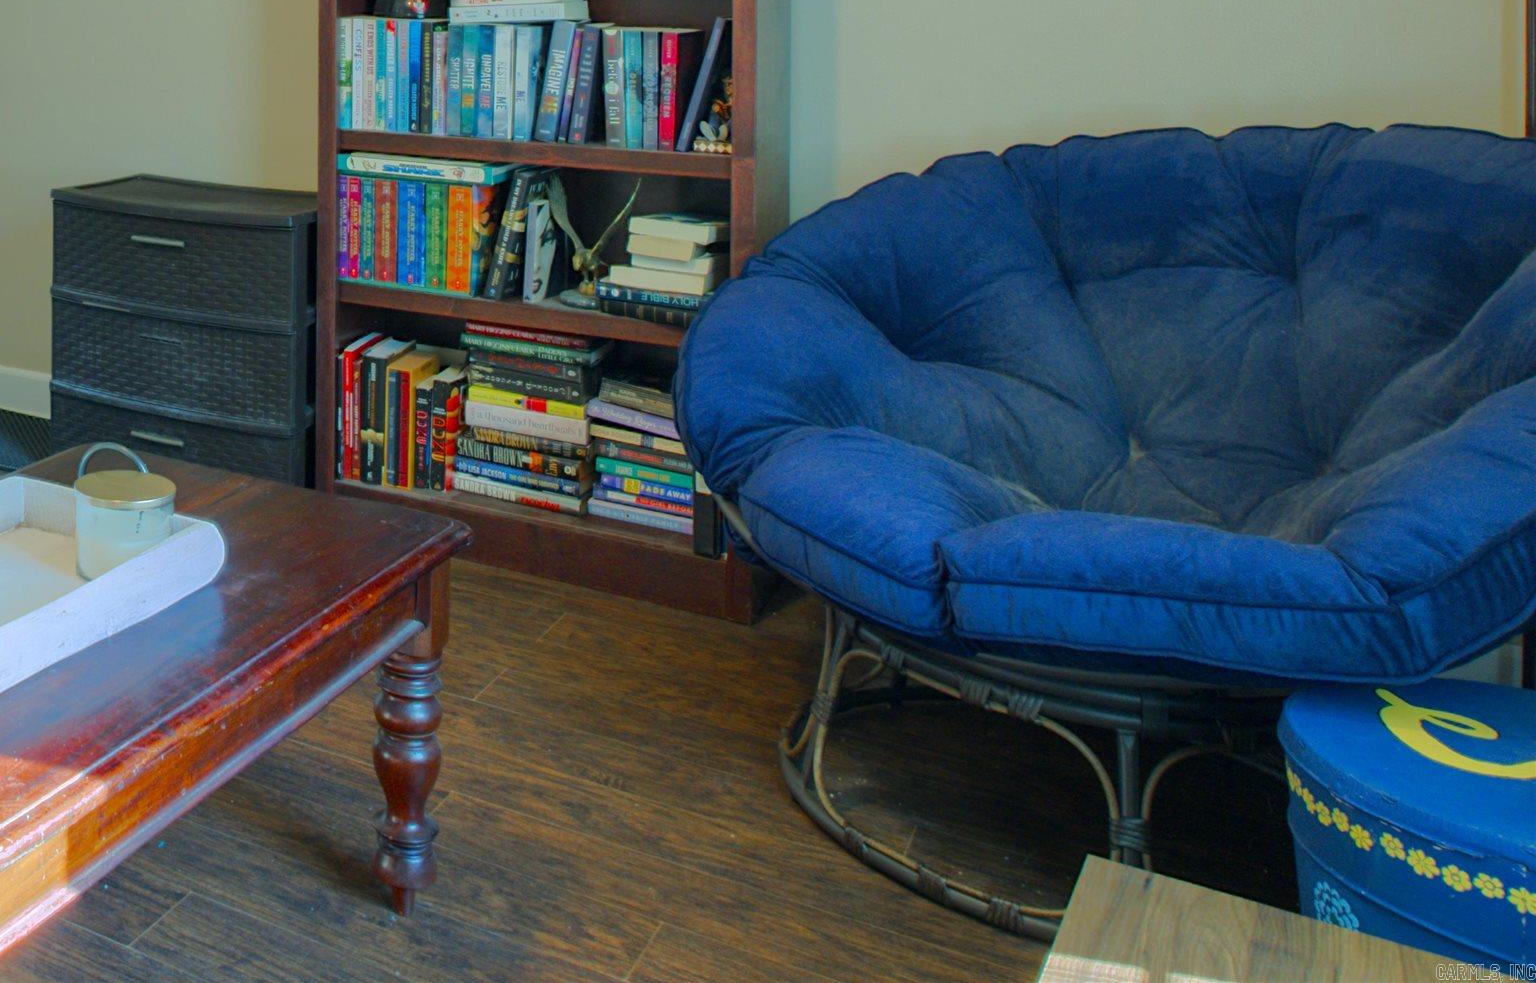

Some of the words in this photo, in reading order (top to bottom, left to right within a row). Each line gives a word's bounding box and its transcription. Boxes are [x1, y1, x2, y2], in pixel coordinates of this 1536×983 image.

[354, 29, 362, 72] CONFESS
[367, 67, 374, 75] US
[449, 57, 460, 90] SHATTER
[462, 58, 474, 90] IGNITE
[480, 54, 492, 92] UNRAVEL
[545, 49, 566, 96] IMAGINE
[480, 95, 492, 108] ME
[496, 96, 507, 110] ME
[516, 90, 526, 103] ME
[663, 76, 672, 118] REQUIEM
[641, 292, 669, 303] BIBLE
[672, 296, 699, 307] HOLY
[464, 336, 482, 347] MARY
[474, 427, 505, 443] SANDRA
[505, 432, 537, 450] BROWN
[457, 438, 490, 460] SANDRA
[492, 443, 523, 467] BROWN
[481, 467, 507, 479] JACKSON
[454, 477, 486, 494] SANDRA
[487, 485, 516, 502] BROWN
[666, 488, 691, 502] AWAY
